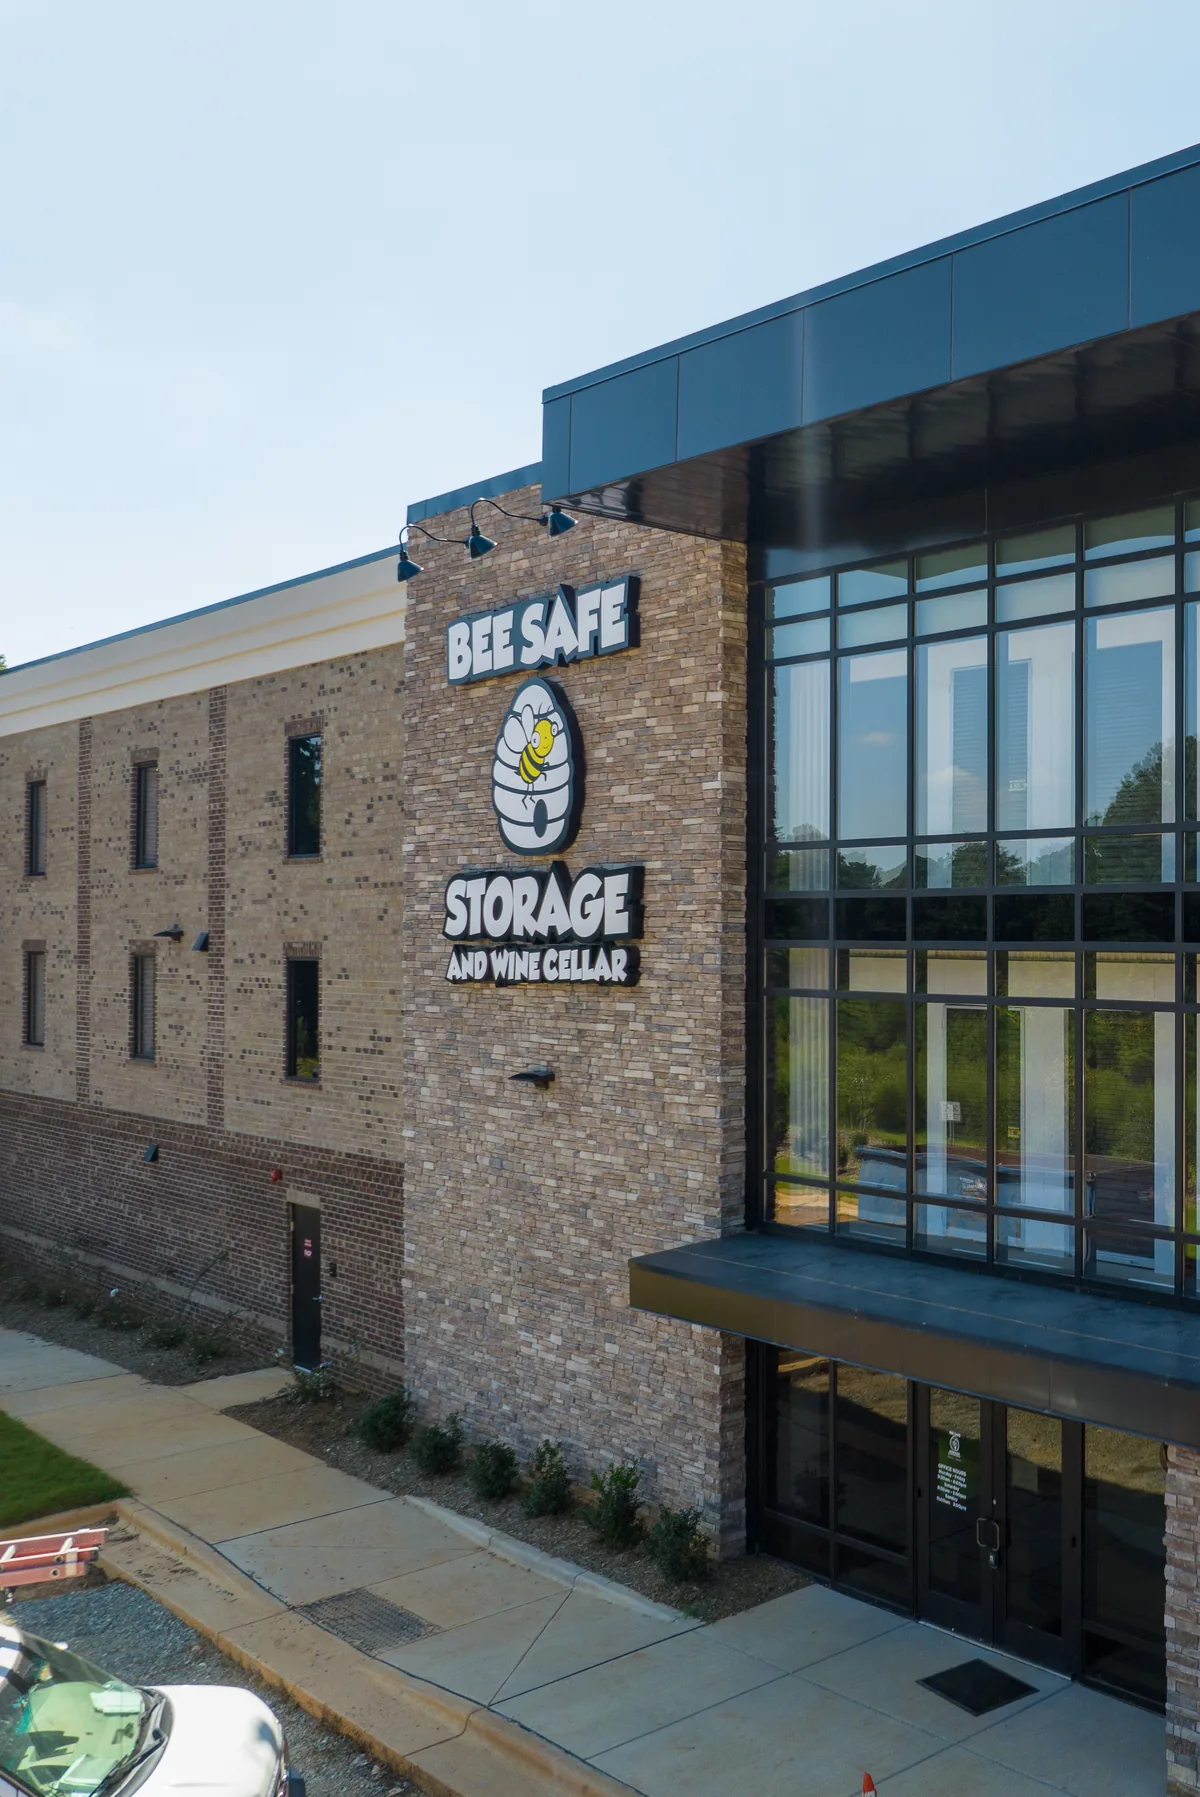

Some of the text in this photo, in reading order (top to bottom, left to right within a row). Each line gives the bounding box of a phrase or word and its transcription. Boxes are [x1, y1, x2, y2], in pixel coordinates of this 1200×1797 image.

[448, 583, 627, 680] BEE SAFE
[445, 869, 629, 938] STORAGE
[447, 949, 627, 981] AND WINE CELLAR
